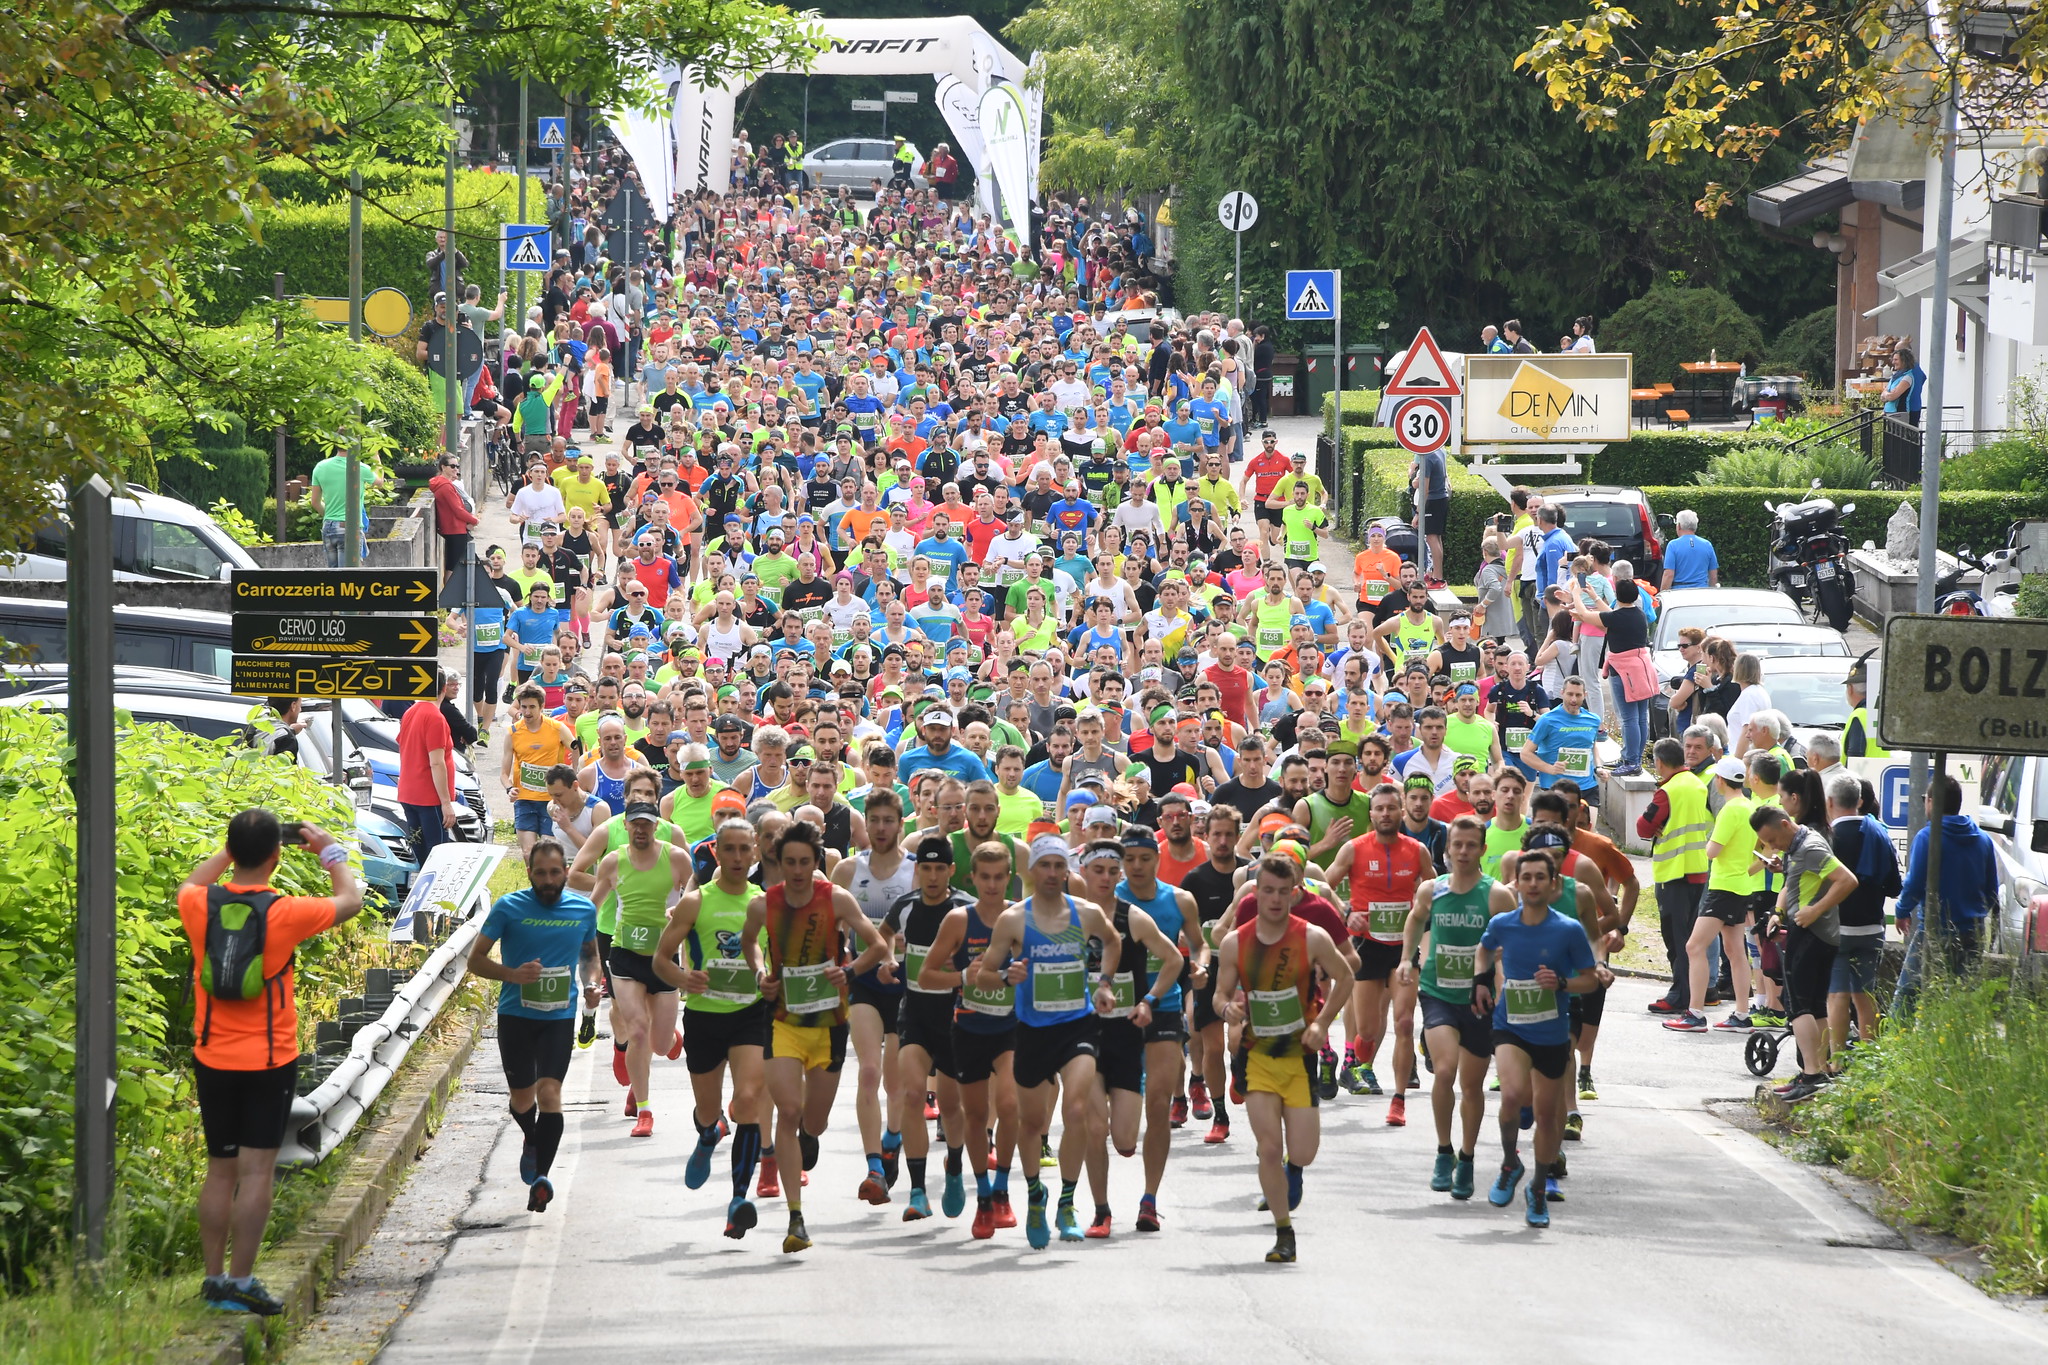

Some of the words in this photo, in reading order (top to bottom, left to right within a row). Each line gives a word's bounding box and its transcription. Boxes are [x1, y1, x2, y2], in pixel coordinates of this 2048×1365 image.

[1223, 202, 1252, 220] 30
[1511, 391, 1540, 417] DE
[1546, 391, 1598, 417] MIN
[1408, 413, 1438, 439] 30
[1511, 424, 1599, 434] arredamenti
[1006, 573, 1020, 582] 389
[237, 582, 335, 597] Carrozzeria
[340, 582, 365, 600] My
[370, 582, 400, 597] Car
[279, 618, 316, 636] CERVO
[321, 619, 346, 637] UGO
[481, 628, 497, 637] 156
[1263, 633, 1279, 641] 468
[235, 660, 274, 668] MACCHINE
[235, 671, 291, 679] L'INDUSTRIA
[1456, 668, 1472, 677] 331
[235, 682, 291, 690] ALIMENTARE
[1564, 754, 1583, 764] 264
[525, 769, 545, 781] 250
[521, 917, 582, 928] DYNAFIT
[1377, 911, 1403, 924] 417
[1435, 912, 1484, 928] TREMALZO
[630, 927, 649, 941] 42
[1444, 956, 1474, 970] 219
[728, 969, 738, 983] 7
[1057, 973, 1064, 990] 1
[538, 977, 557, 992] 10
[806, 975, 818, 992] 2
[1515, 988, 1544, 1004] 117
[1268, 1001, 1280, 1017] 3
